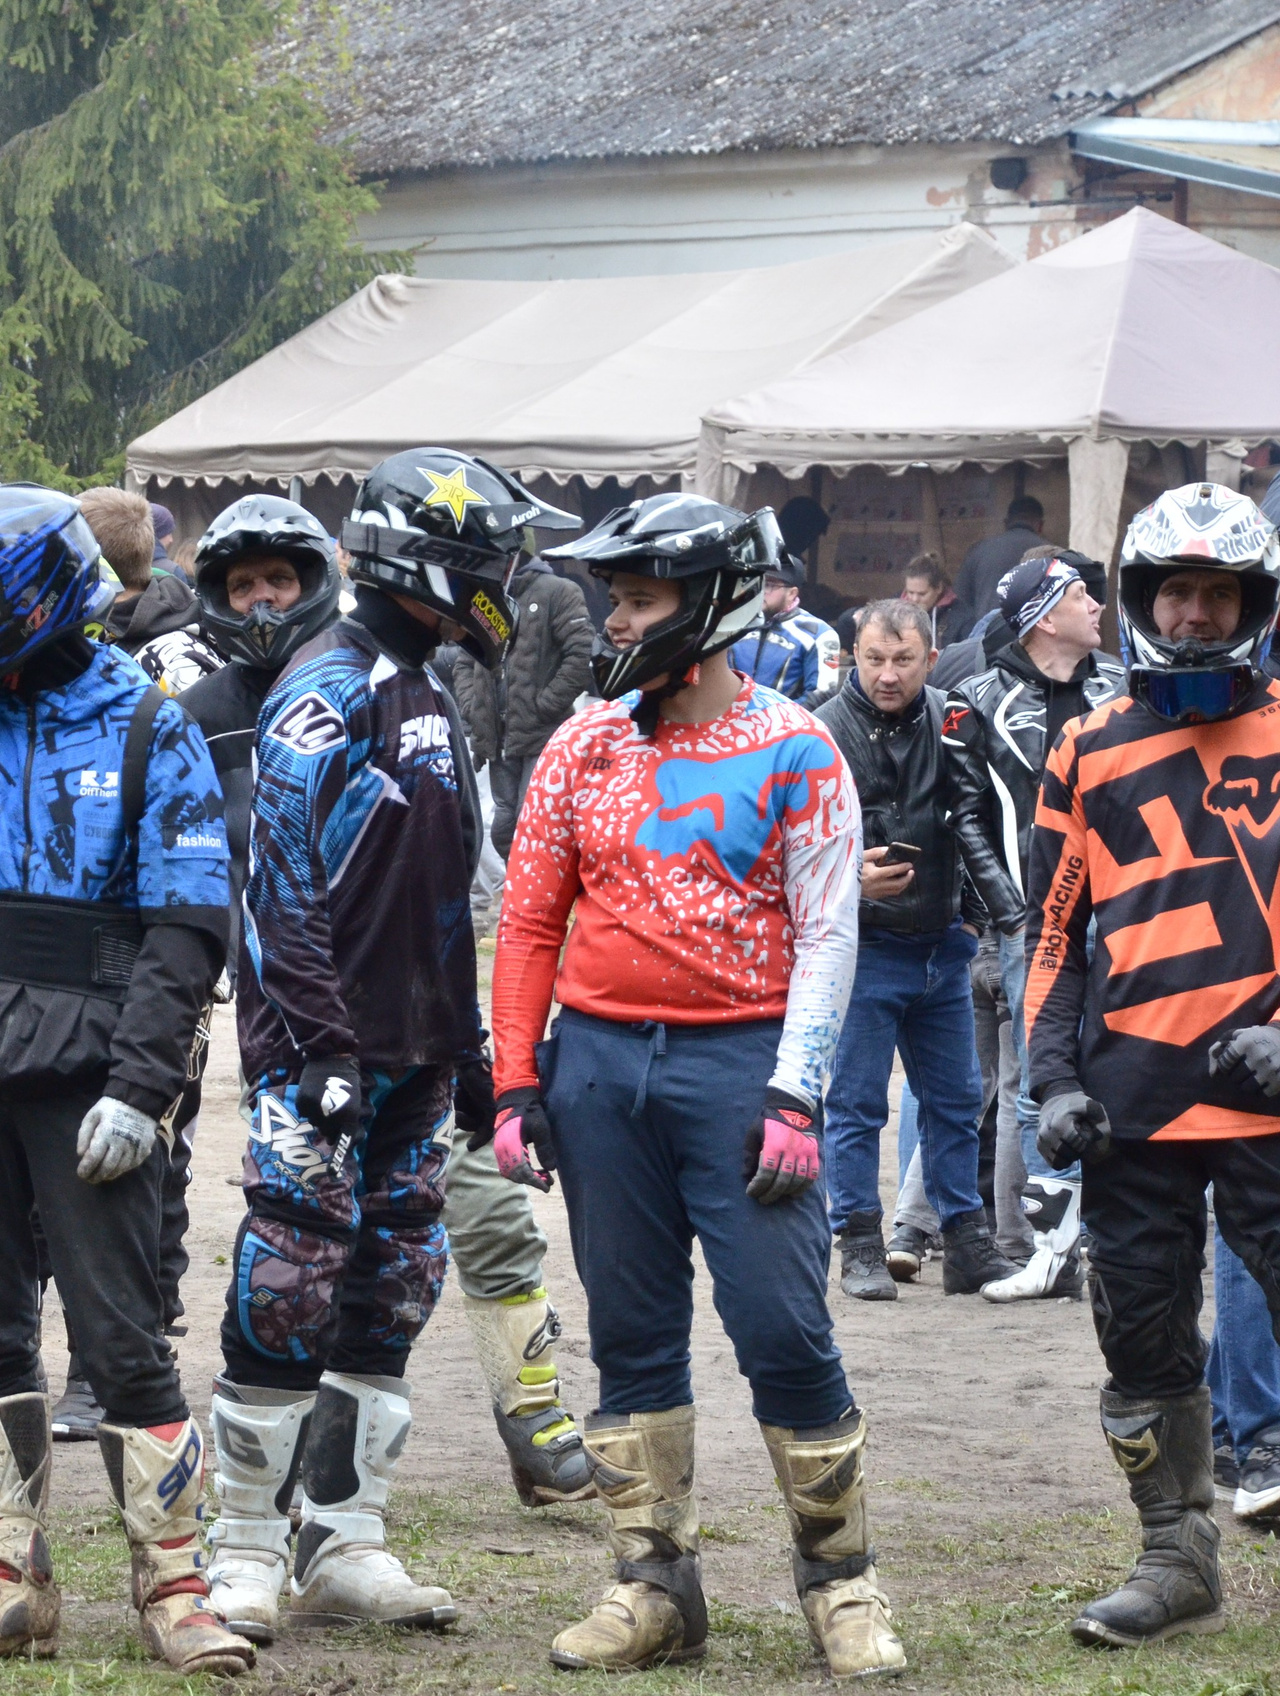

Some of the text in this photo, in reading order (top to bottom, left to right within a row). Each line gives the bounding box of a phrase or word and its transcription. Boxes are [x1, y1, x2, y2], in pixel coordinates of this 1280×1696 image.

[511, 505, 542, 527] Airoh
[398, 714, 451, 762] SHO
[176, 834, 222, 848] fashion
[1039, 854, 1083, 972] @FOXACING
[330, 1132, 352, 1177] THOR
